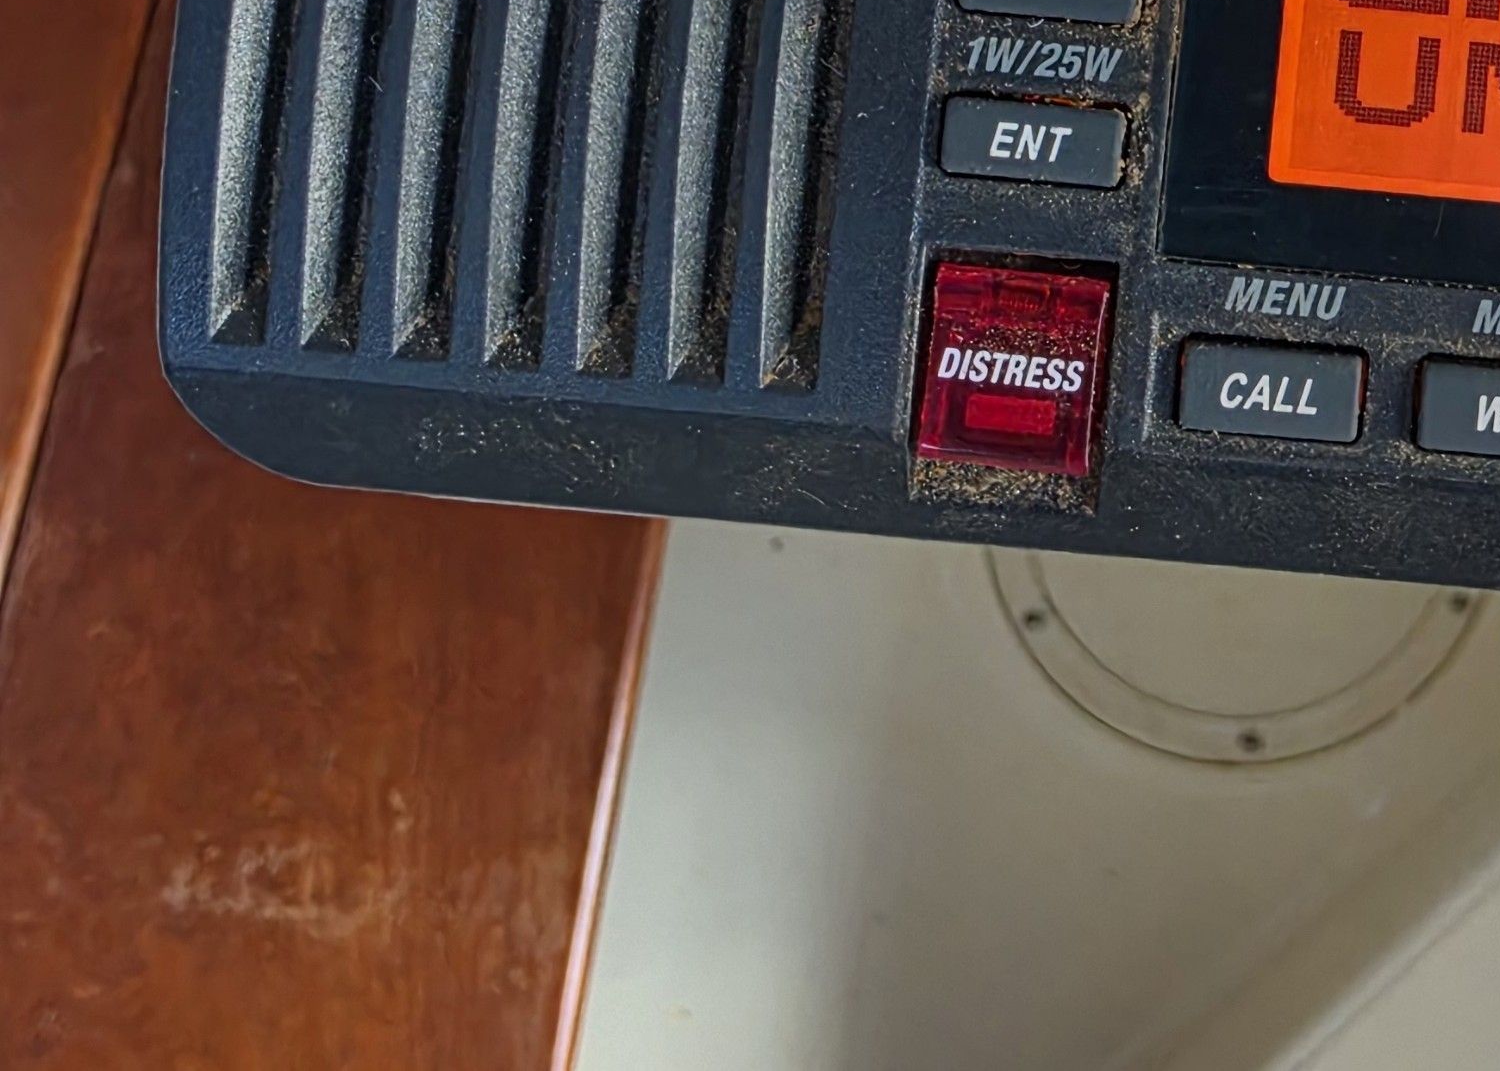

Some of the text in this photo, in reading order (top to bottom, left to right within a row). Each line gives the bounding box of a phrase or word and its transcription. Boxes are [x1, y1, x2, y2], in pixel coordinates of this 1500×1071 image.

[966, 36, 1122, 84] 1W/25W
[989, 122, 1071, 163] ENT
[1224, 275, 1346, 321] MENU
[937, 347, 1085, 392] DISTRESS
[1219, 372, 1319, 416] CALL
